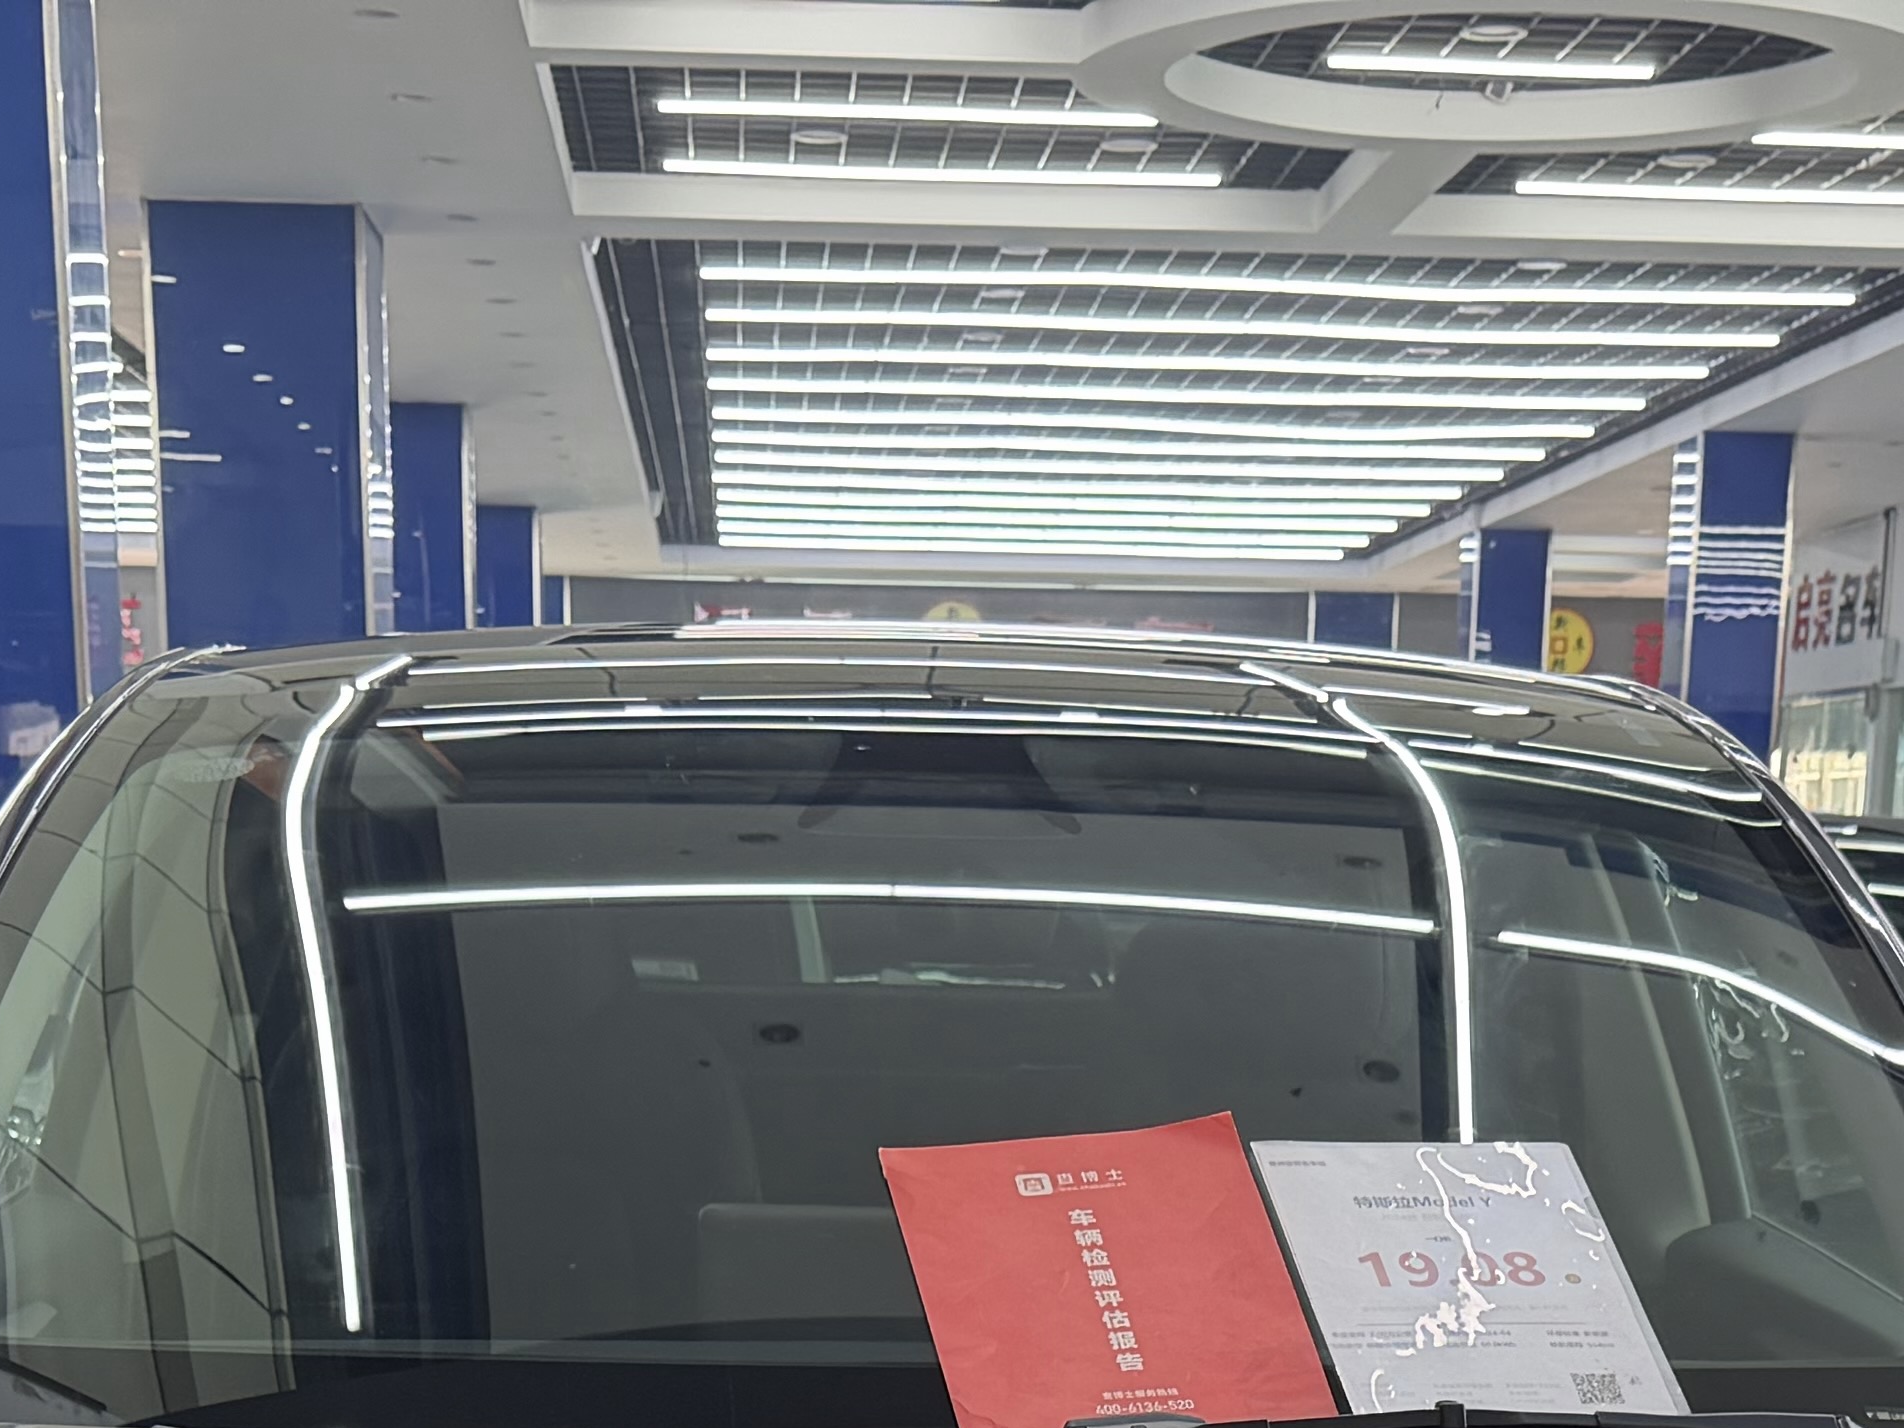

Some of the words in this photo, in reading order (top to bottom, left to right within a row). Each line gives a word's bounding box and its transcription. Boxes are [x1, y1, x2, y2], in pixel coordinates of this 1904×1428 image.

[1479, 1196, 1493, 1208] Y
[1067, 1208, 1145, 1372] 车辆检测评估报告
